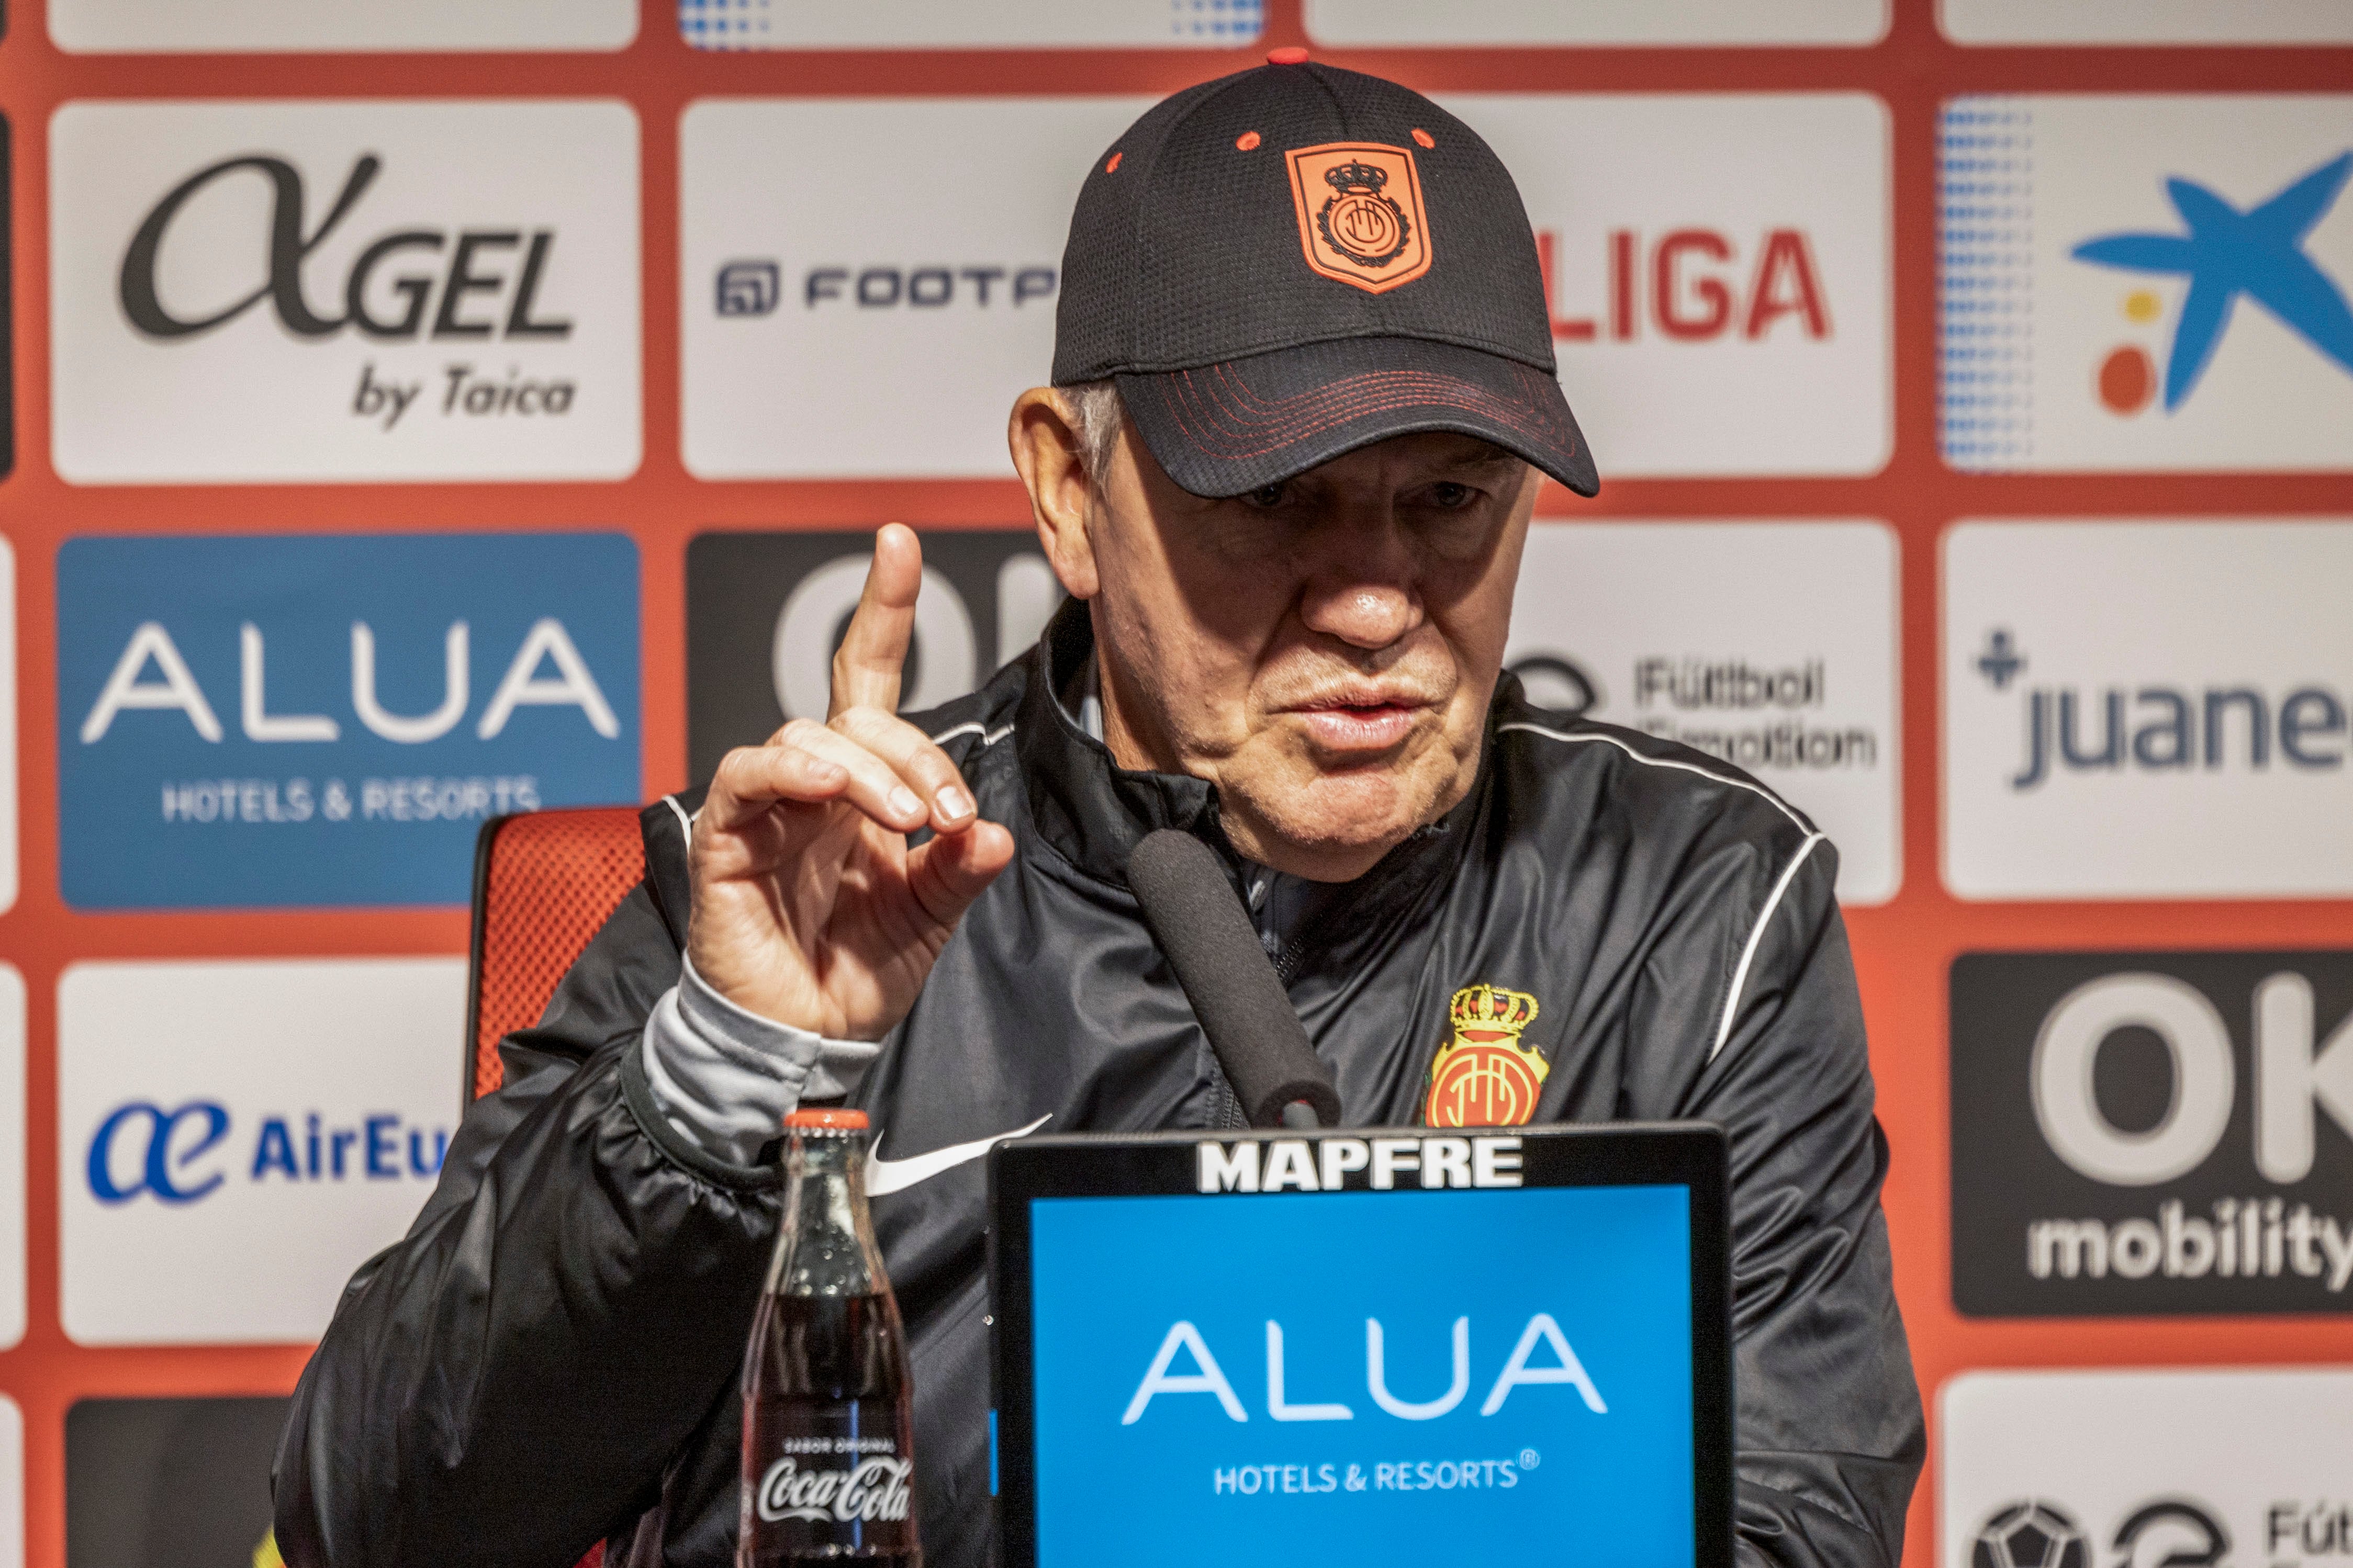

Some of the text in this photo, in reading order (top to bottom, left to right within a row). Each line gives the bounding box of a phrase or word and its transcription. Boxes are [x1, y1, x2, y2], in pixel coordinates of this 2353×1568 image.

[351, 362, 577, 432] by Taica
[80, 618, 621, 744] ALUA
[161, 775, 542, 822] HOTELS & RESORTS
[1197, 1136, 1523, 1194] MAPFRE
[2029, 1198, 2353, 1291] mobility
[1120, 1312, 1609, 1426] ALUA
[1214, 1463, 1338, 1495] HOTELS
[1343, 1463, 1367, 1492] &
